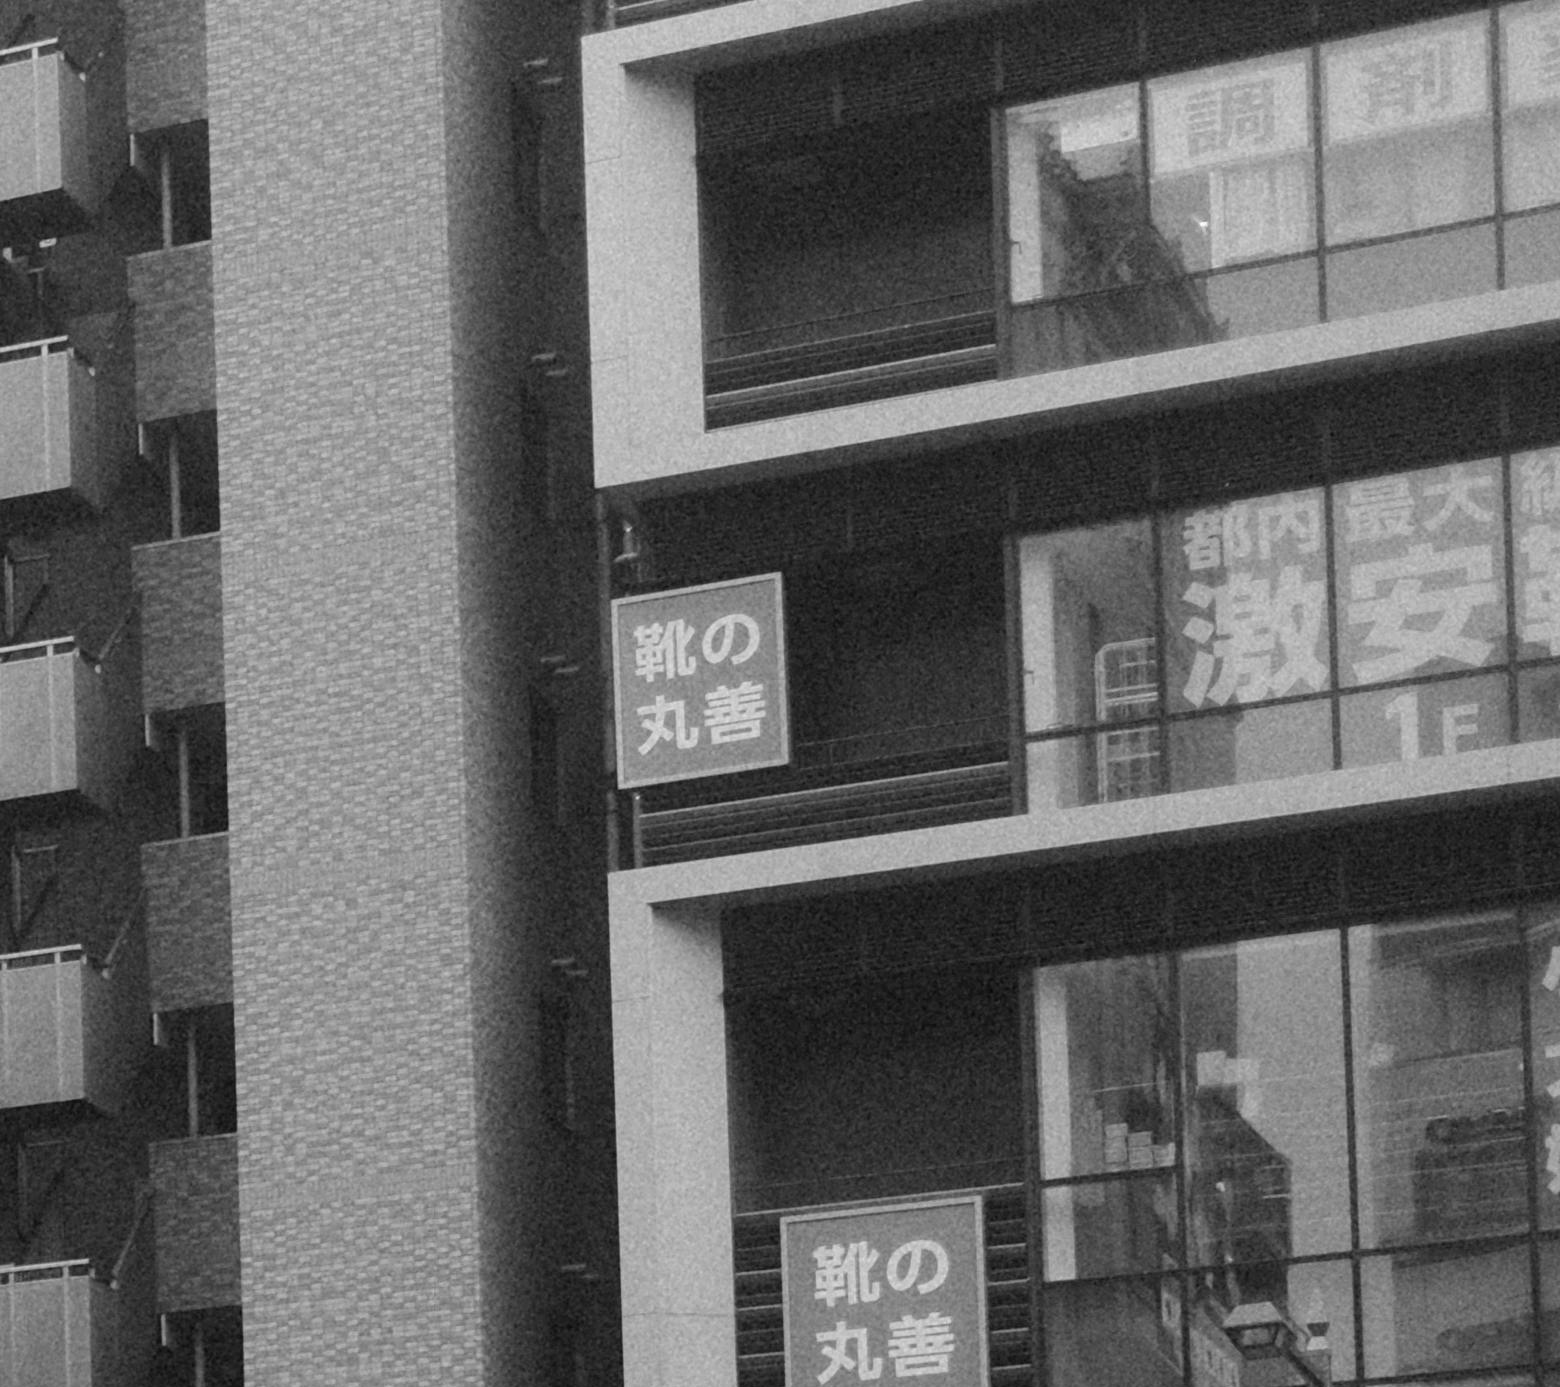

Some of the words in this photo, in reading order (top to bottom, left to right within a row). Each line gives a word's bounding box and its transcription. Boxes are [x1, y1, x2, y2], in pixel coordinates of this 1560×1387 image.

[634, 611, 760, 681] 靴の
[638, 682, 767, 755] 丸善
[812, 1237, 950, 1307] 靴の
[816, 1313, 957, 1386] 丸善
